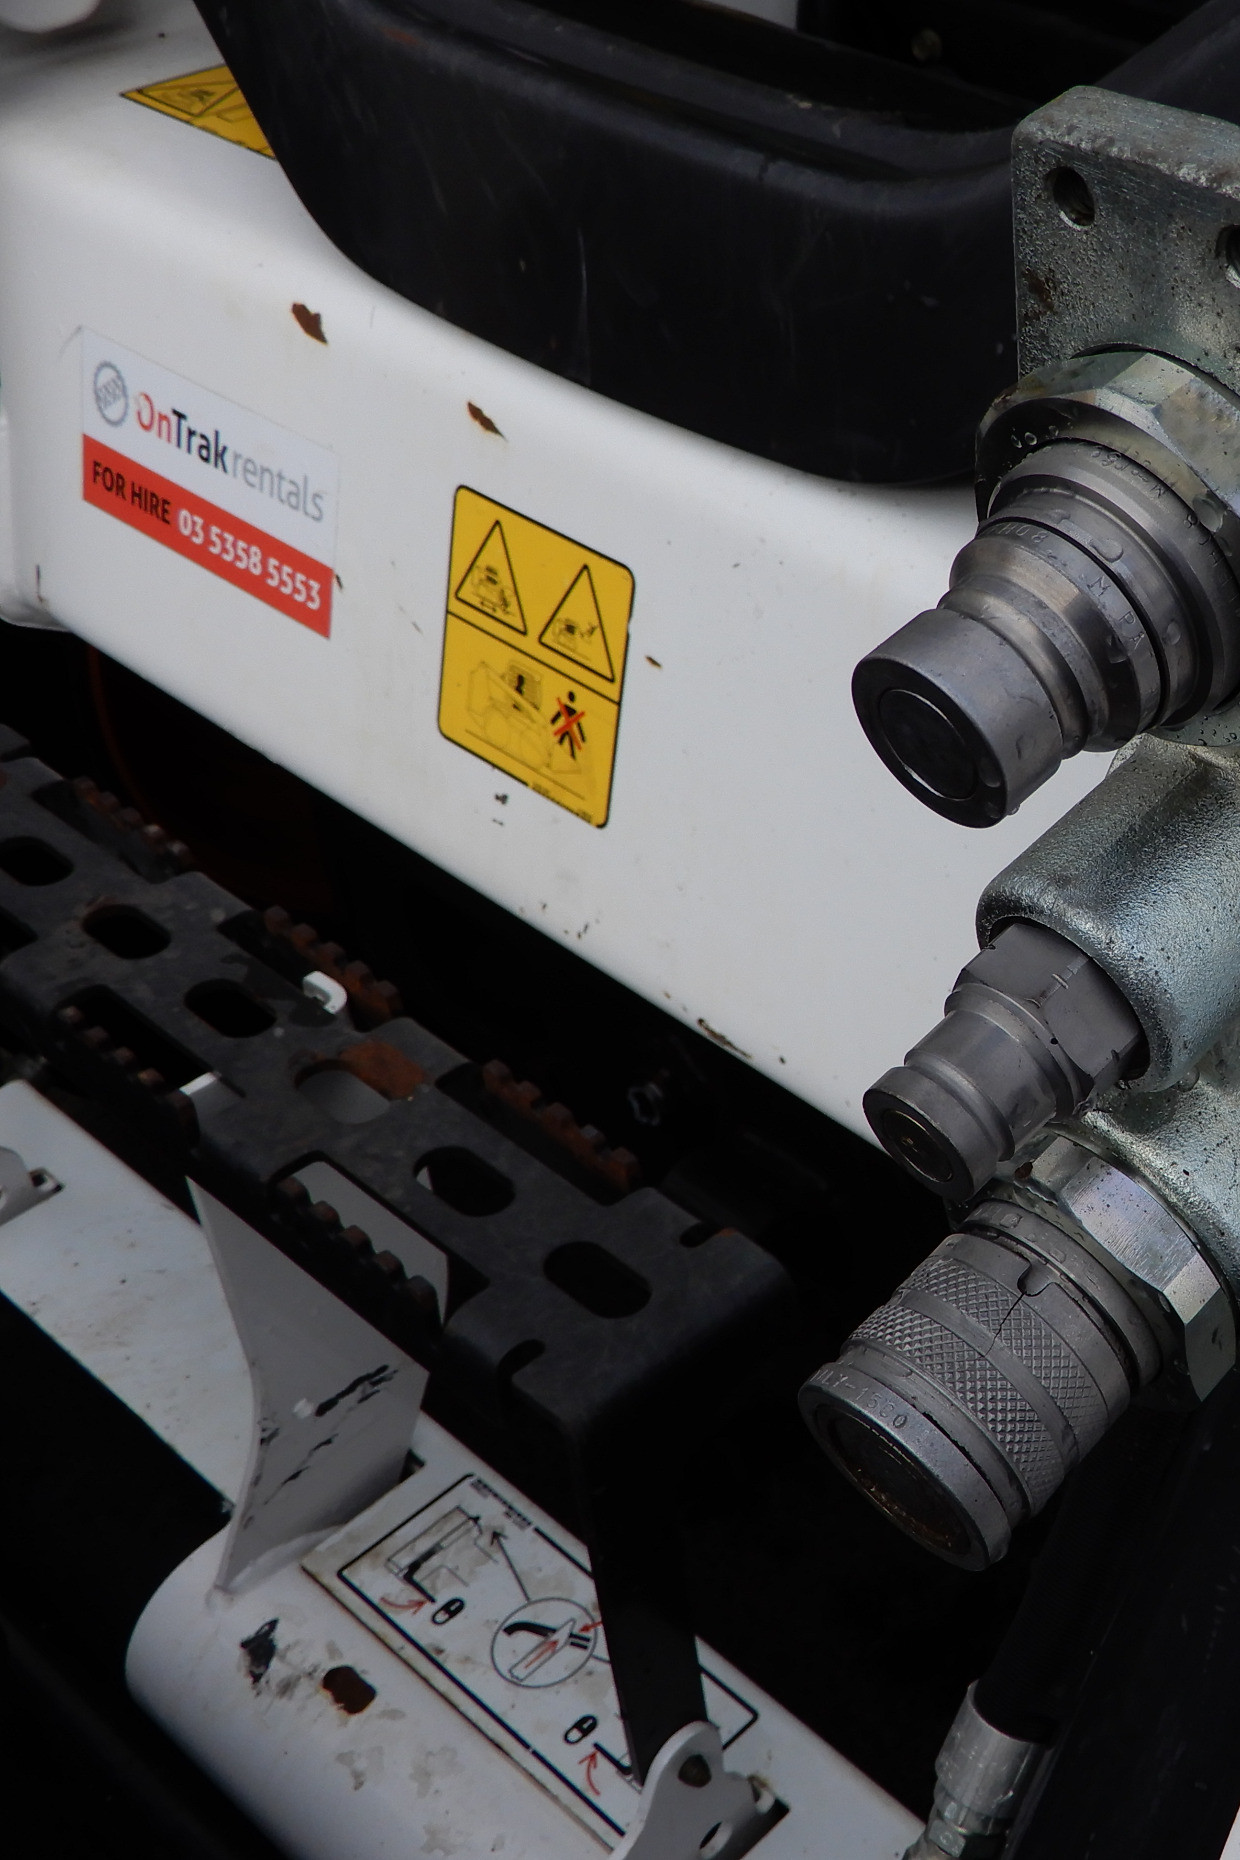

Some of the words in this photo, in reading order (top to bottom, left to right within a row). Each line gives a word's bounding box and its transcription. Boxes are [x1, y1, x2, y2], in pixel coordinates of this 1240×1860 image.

[92, 461, 126, 499] FOR
[131, 482, 171, 525] HIRE
[178, 509, 204, 545] 03
[208, 526, 262, 576] 5358
[266, 559, 321, 610] 5553
